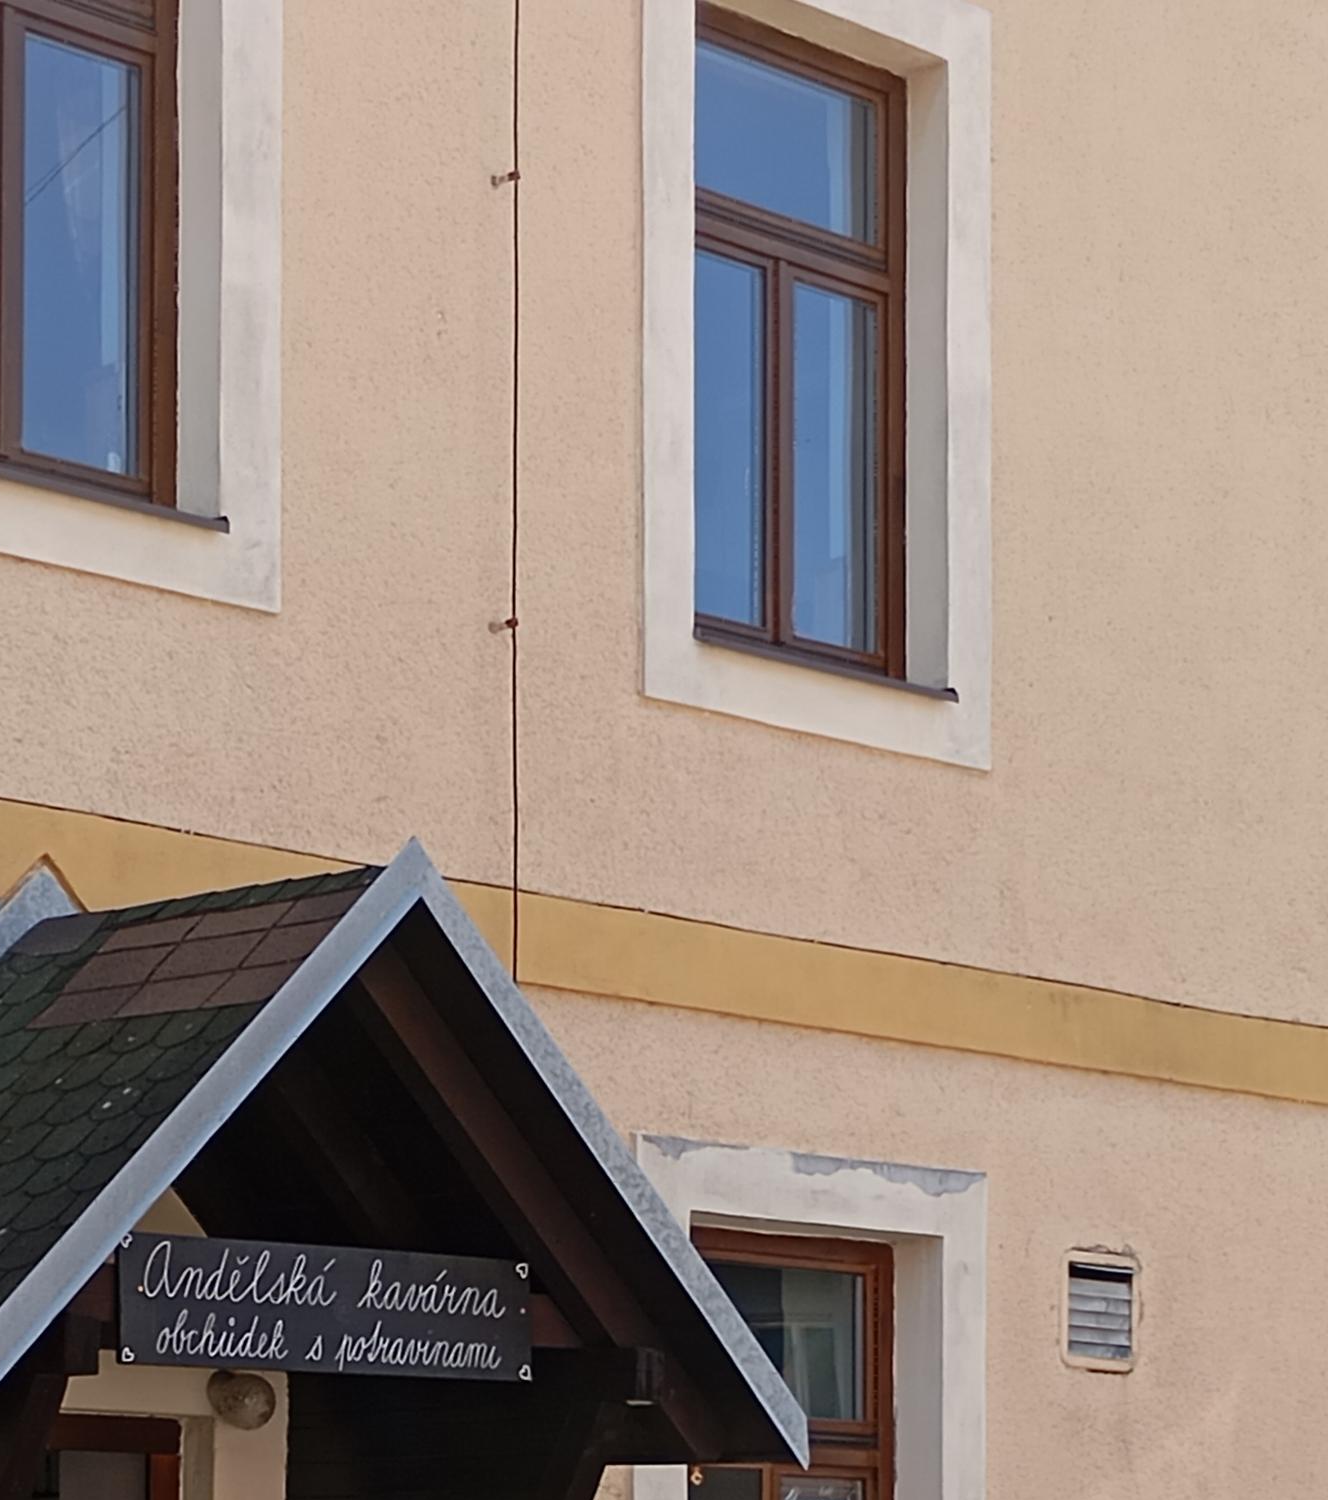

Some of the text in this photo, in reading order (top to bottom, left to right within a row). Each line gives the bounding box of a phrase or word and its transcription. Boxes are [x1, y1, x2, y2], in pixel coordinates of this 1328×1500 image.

[142, 1240, 506, 1319] Andělská kavárna
[156, 1309, 503, 1371] obchůdek s potravinami
